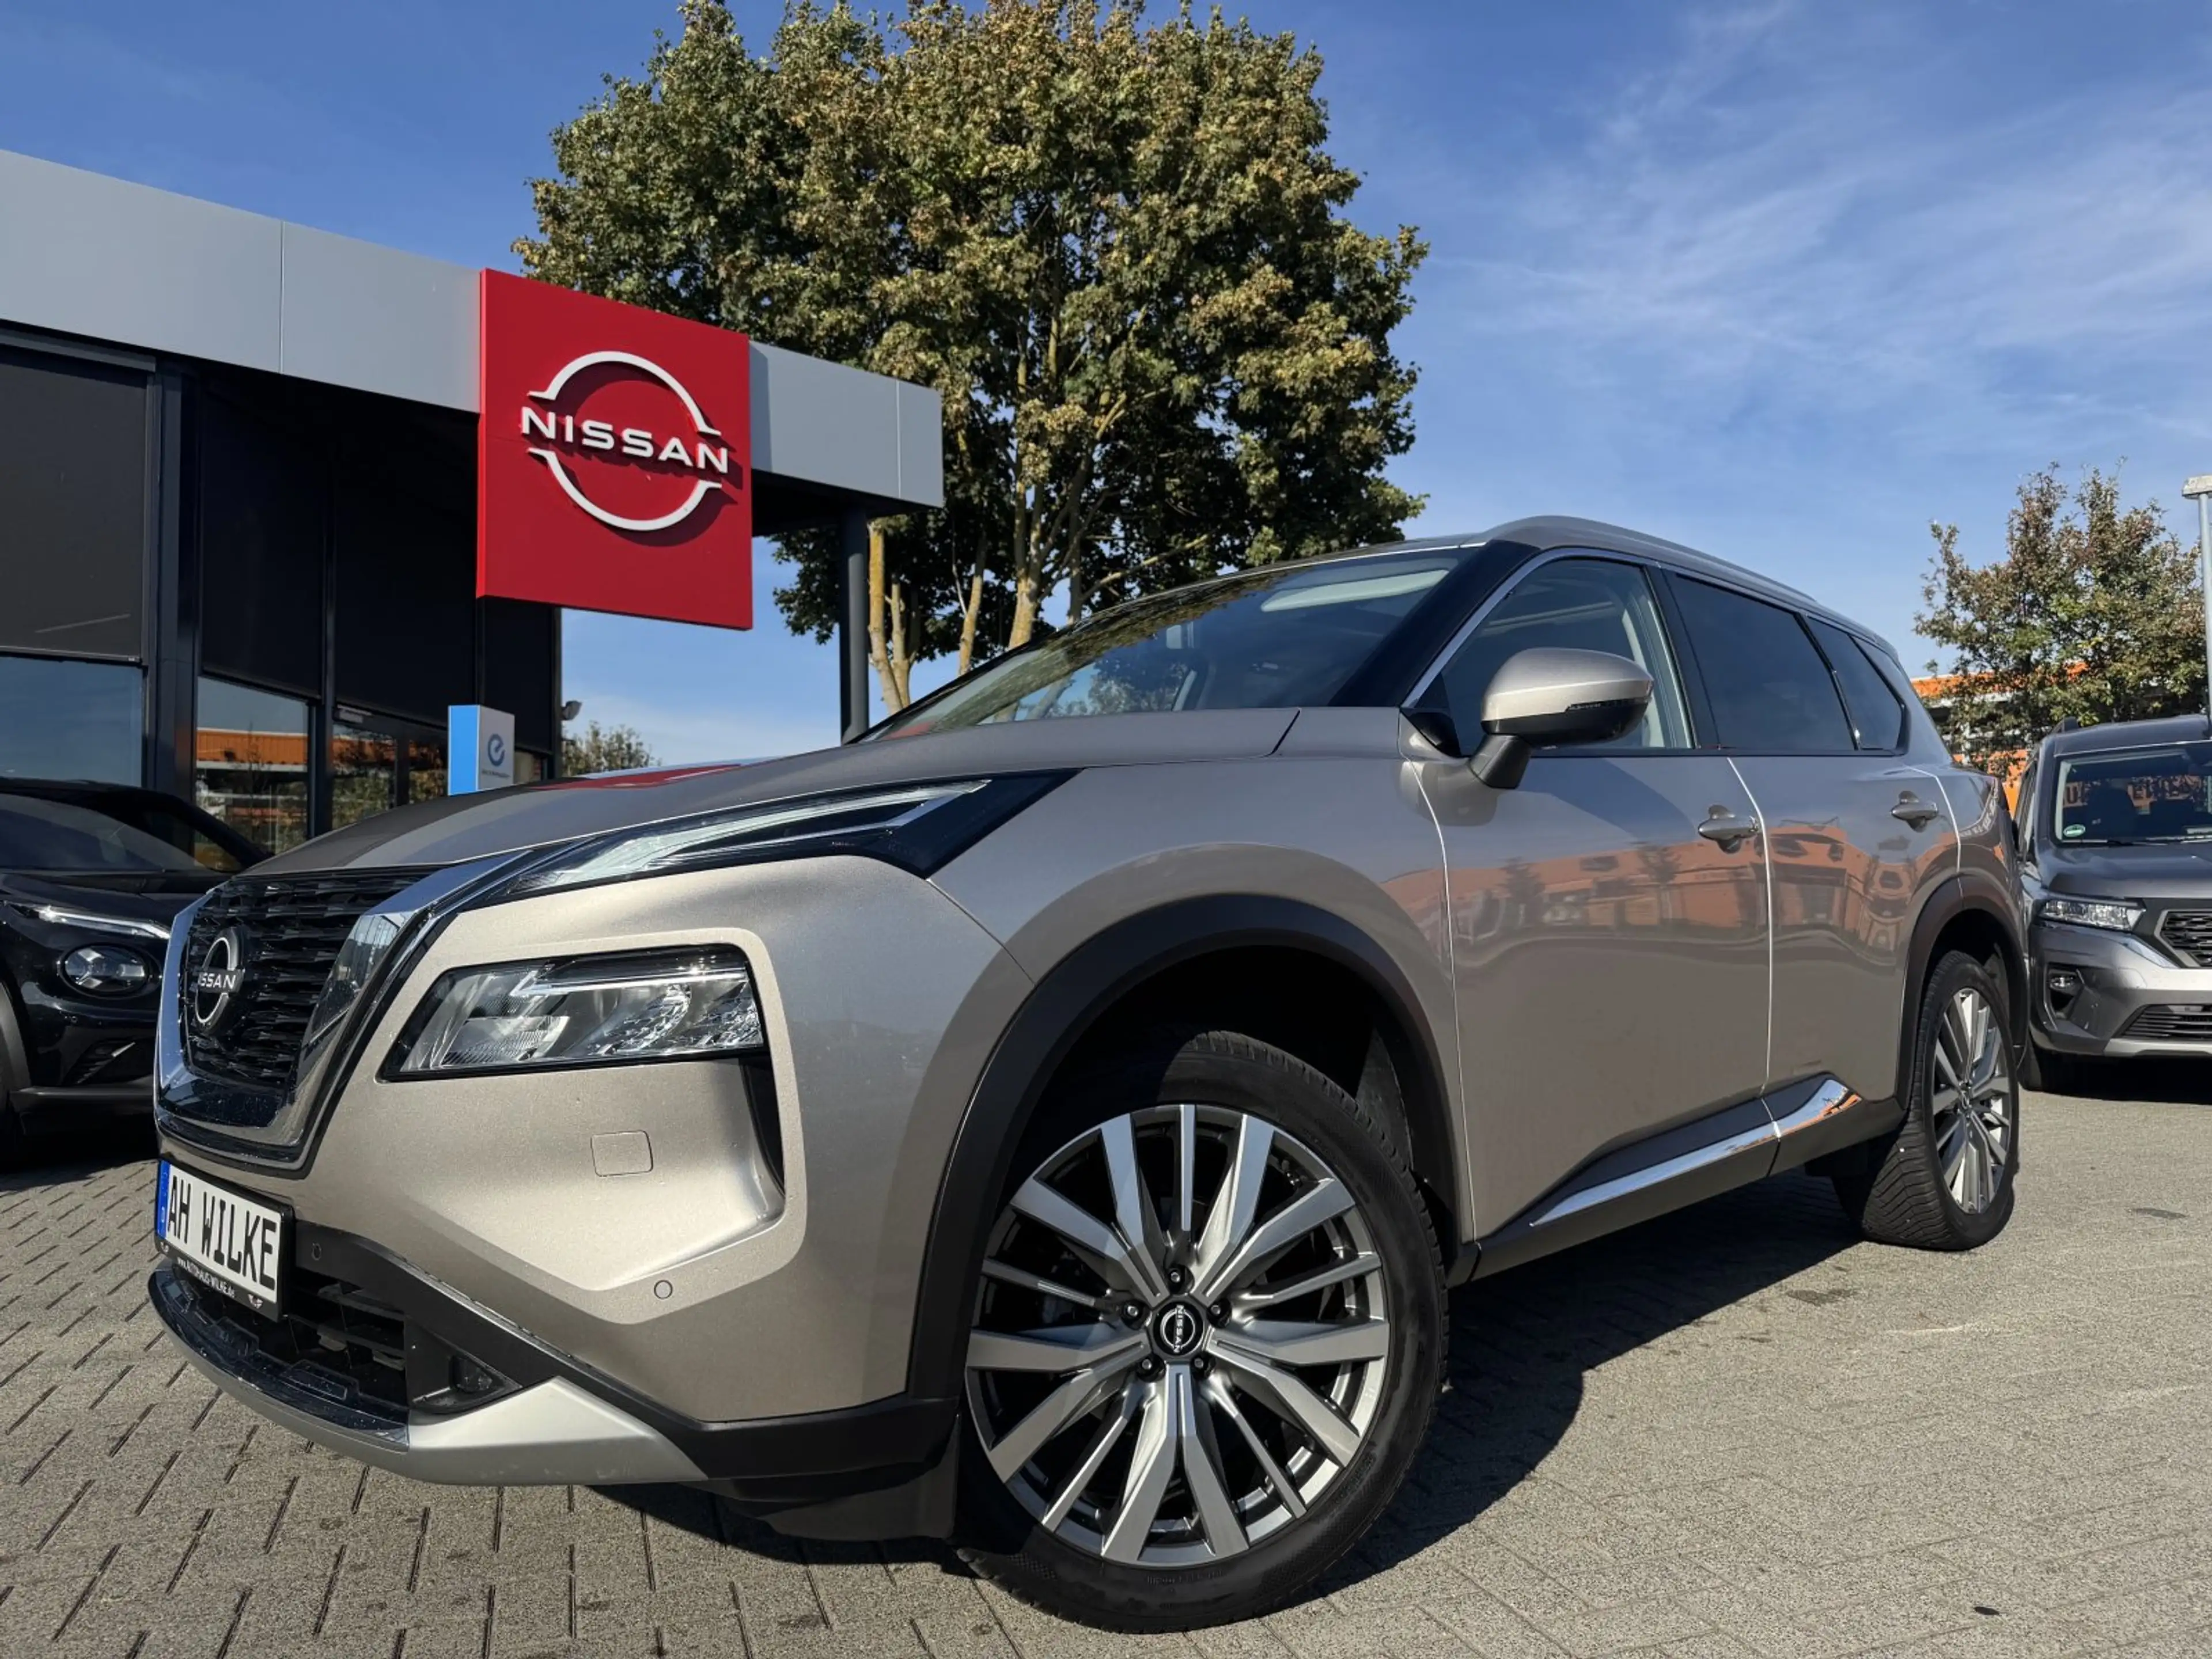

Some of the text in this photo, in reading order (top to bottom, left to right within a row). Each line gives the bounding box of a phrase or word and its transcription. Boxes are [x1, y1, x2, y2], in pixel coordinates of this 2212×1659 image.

[521, 406, 728, 474] NISSAN
[168, 1175, 191, 1244] AH
[202, 1191, 277, 1291] WILKE
[1173, 1304, 1184, 1353] NISSAN
